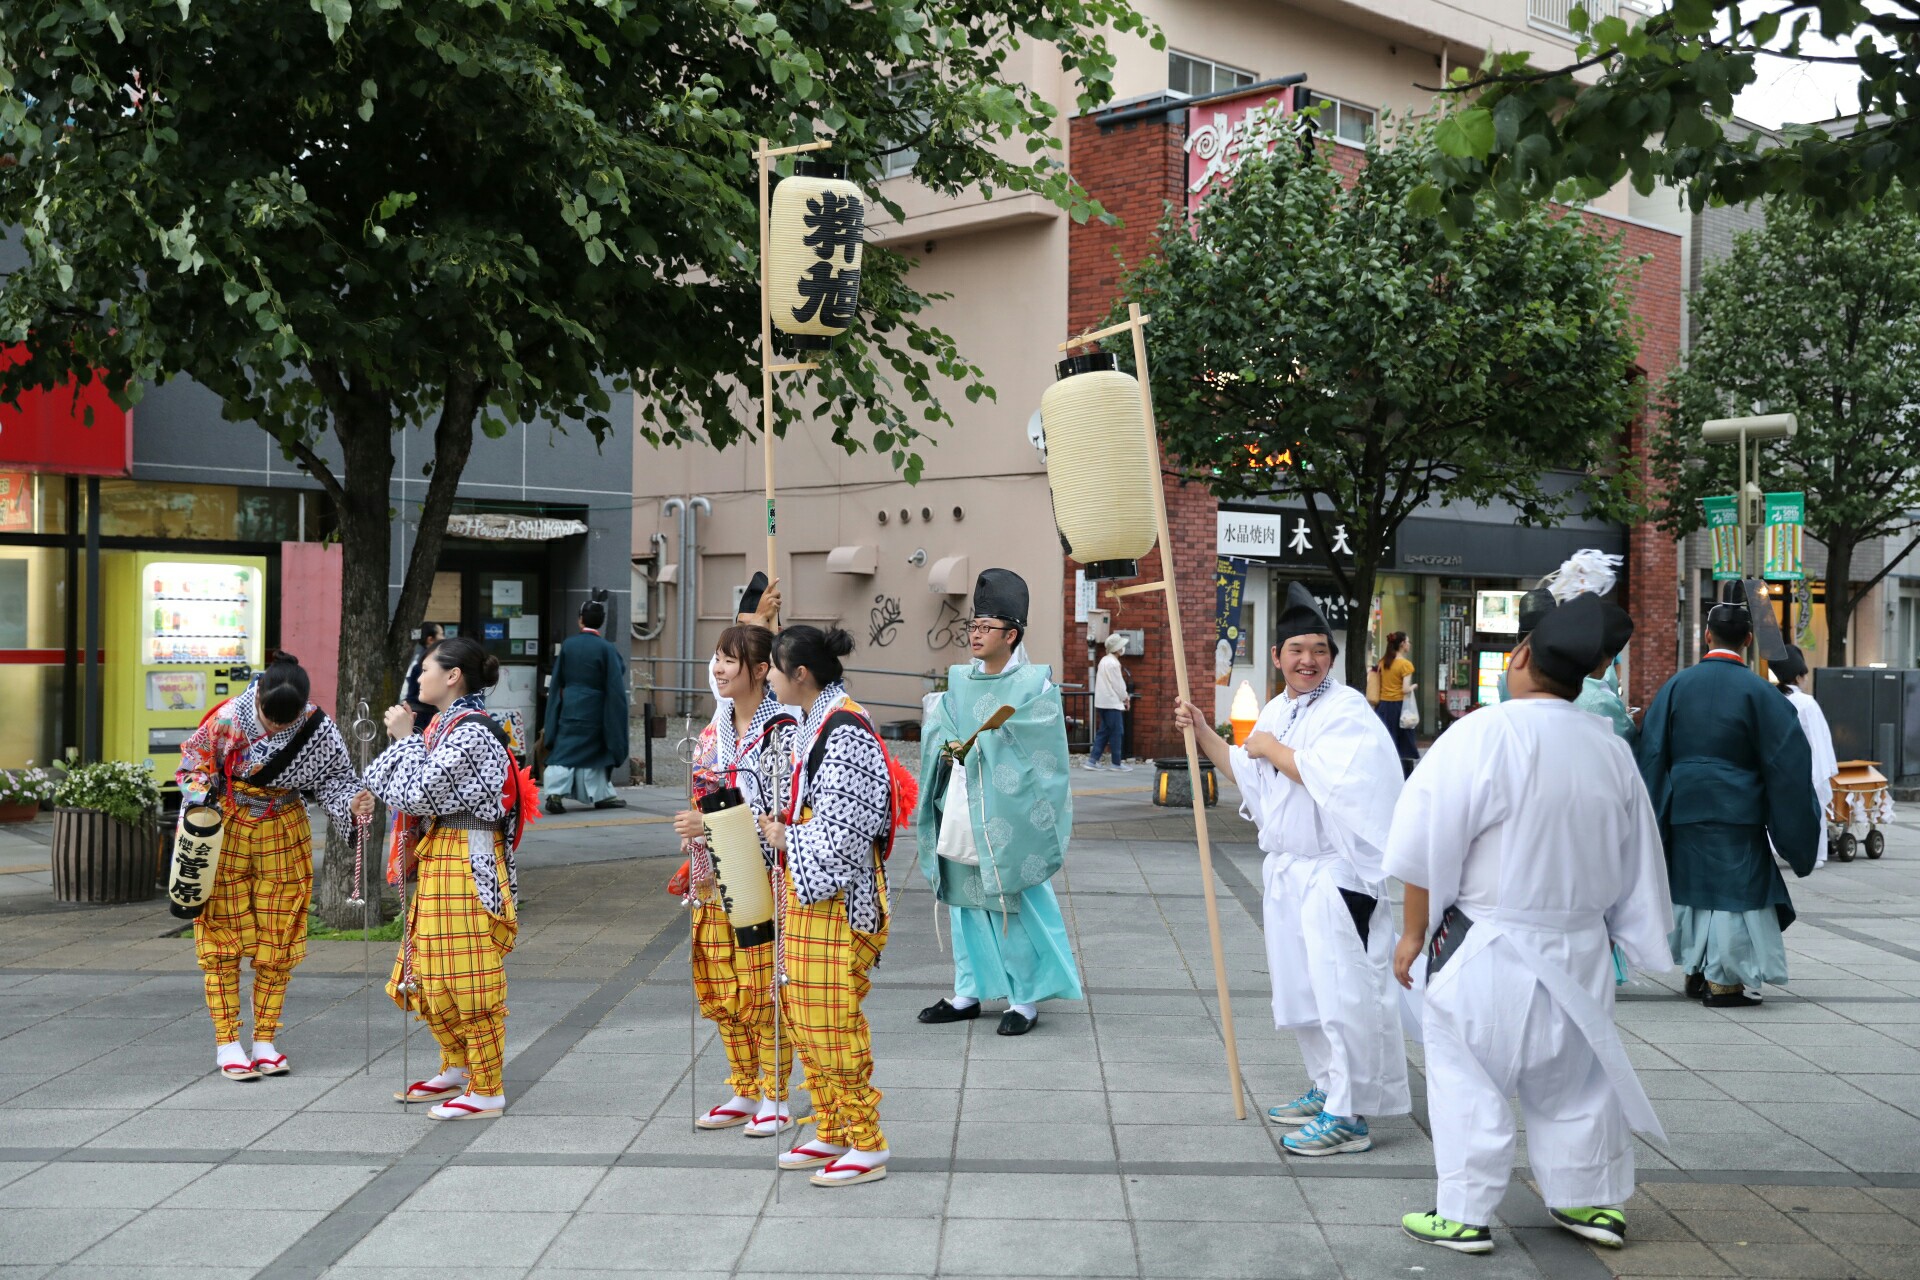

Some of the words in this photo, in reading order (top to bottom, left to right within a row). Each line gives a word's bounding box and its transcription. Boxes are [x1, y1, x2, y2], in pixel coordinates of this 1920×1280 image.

[1223, 523, 1275, 545] 水晶焼肉
[1231, 580, 1240, 608] 北海道
